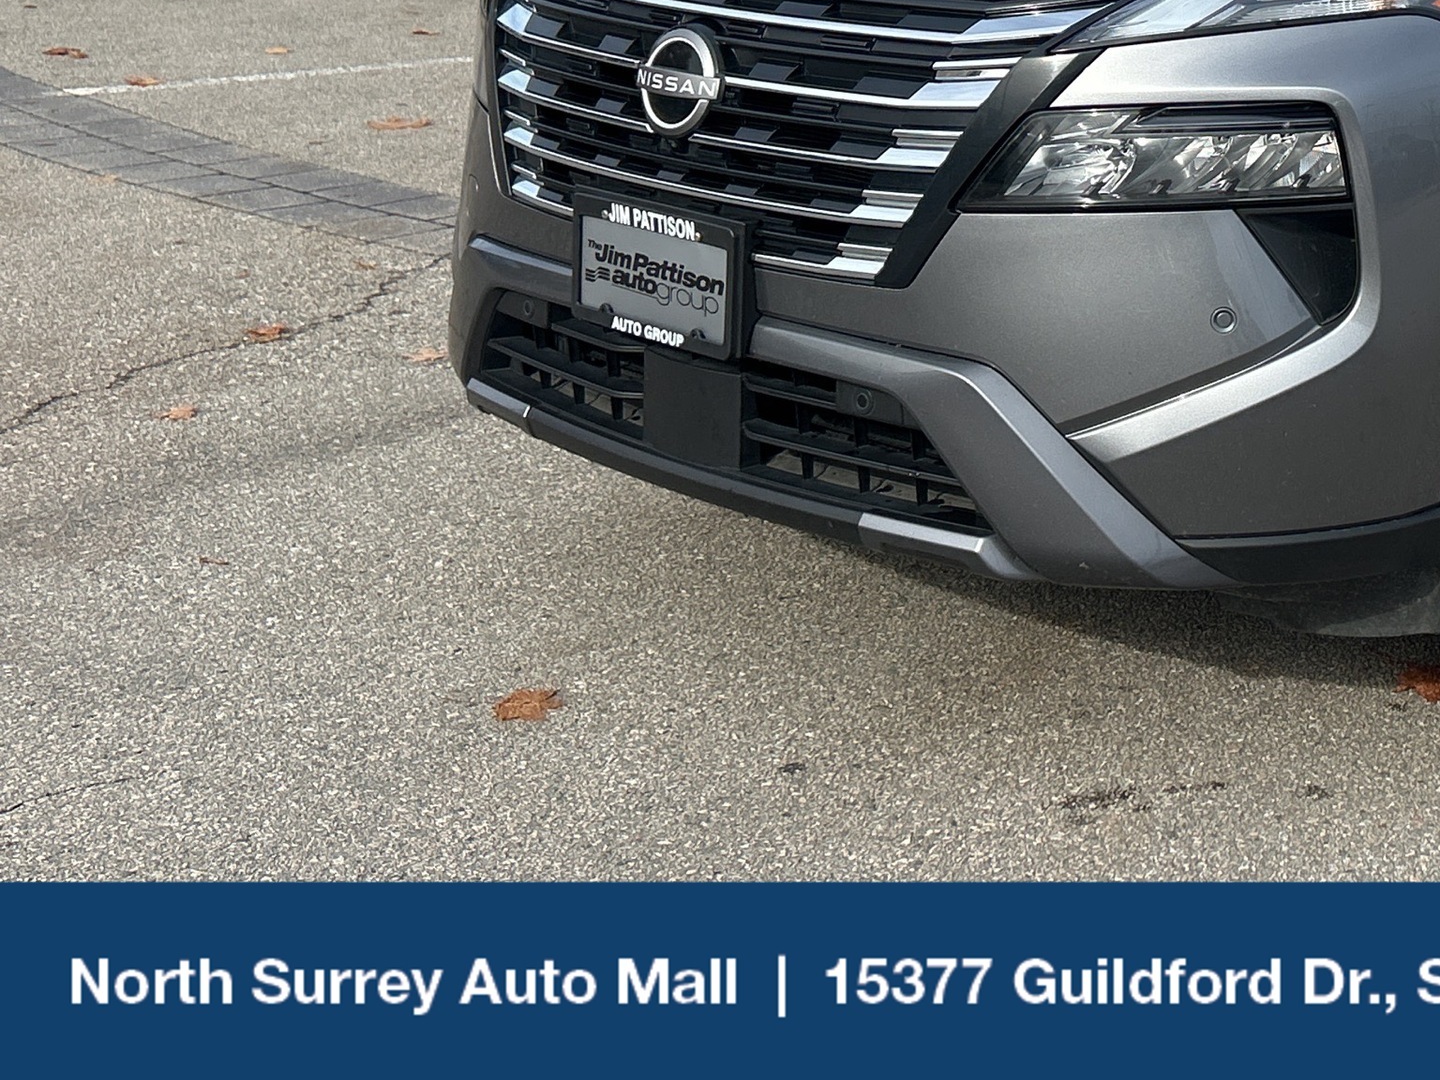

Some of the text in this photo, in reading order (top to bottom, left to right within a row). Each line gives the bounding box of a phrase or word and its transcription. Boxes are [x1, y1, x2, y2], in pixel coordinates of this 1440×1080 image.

[637, 68, 717, 97] NISSAN
[608, 202, 696, 241] JIM PATTISON
[611, 315, 685, 348] AUTO GROUP
